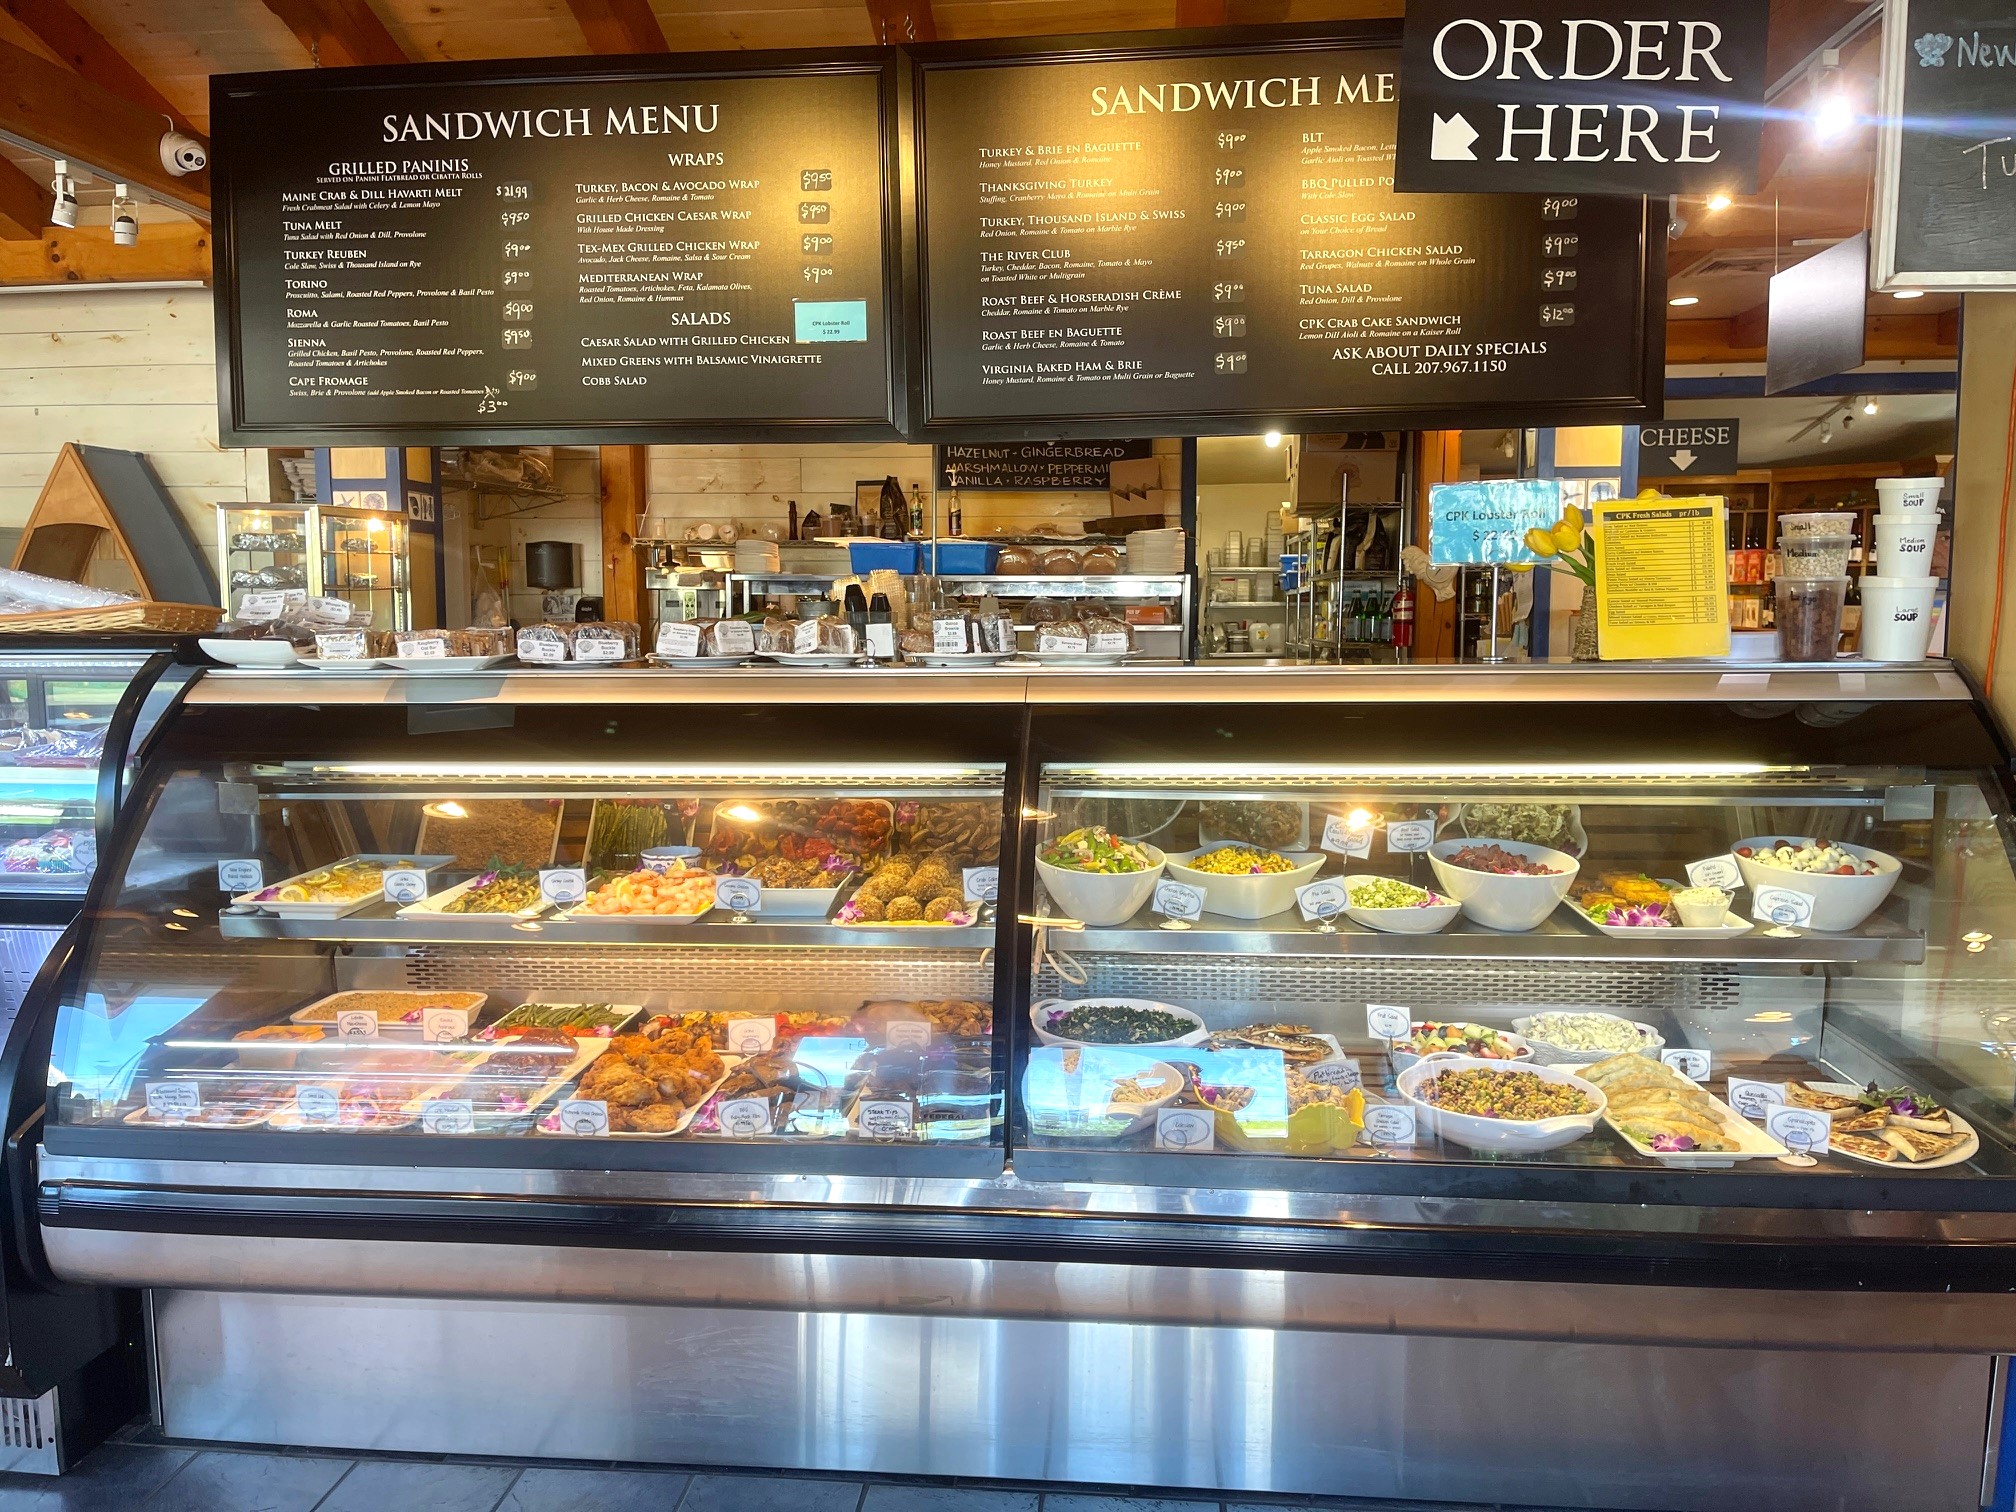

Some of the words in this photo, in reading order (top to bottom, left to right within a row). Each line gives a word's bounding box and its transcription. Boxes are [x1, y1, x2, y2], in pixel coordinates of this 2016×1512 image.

[1432, 18, 1733, 83] ORDER
[1091, 76, 1321, 117] SANDWICH
[1333, 73, 1396, 105] ME
[383, 108, 592, 143] SANDWICH
[604, 104, 719, 136] MENU
[1495, 103, 1722, 165] HERE
[668, 152, 723, 166] WRAPS
[329, 161, 396, 176] GRILLED
[402, 159, 468, 175] PANINIS
[1378, 176, 1394, 186] PO
[671, 312, 730, 325] SALADS
[1332, 347, 1362, 359] ASK
[1364, 345, 1420, 358] ABOUT
[1425, 344, 1471, 356] DAILY
[1475, 342, 1546, 355] SPECIALS
[1371, 362, 1410, 375] CALL
[1414, 360, 1506, 373] 207.967.1150
[1640, 426, 1730, 448] CHEESE
[947, 445, 1011, 459] HAZELNUT
[1021, 446, 1125, 458] GINGERBREAD
[1048, 463, 1109, 475] PEPPERMI
[1014, 476, 1107, 486] RASPBERRY
[1903, 499, 1925, 507] SOUP
[1446, 511, 1469, 521] CPK
[1899, 544, 1926, 553] SOUP
[1893, 613, 1919, 622] SOUP
